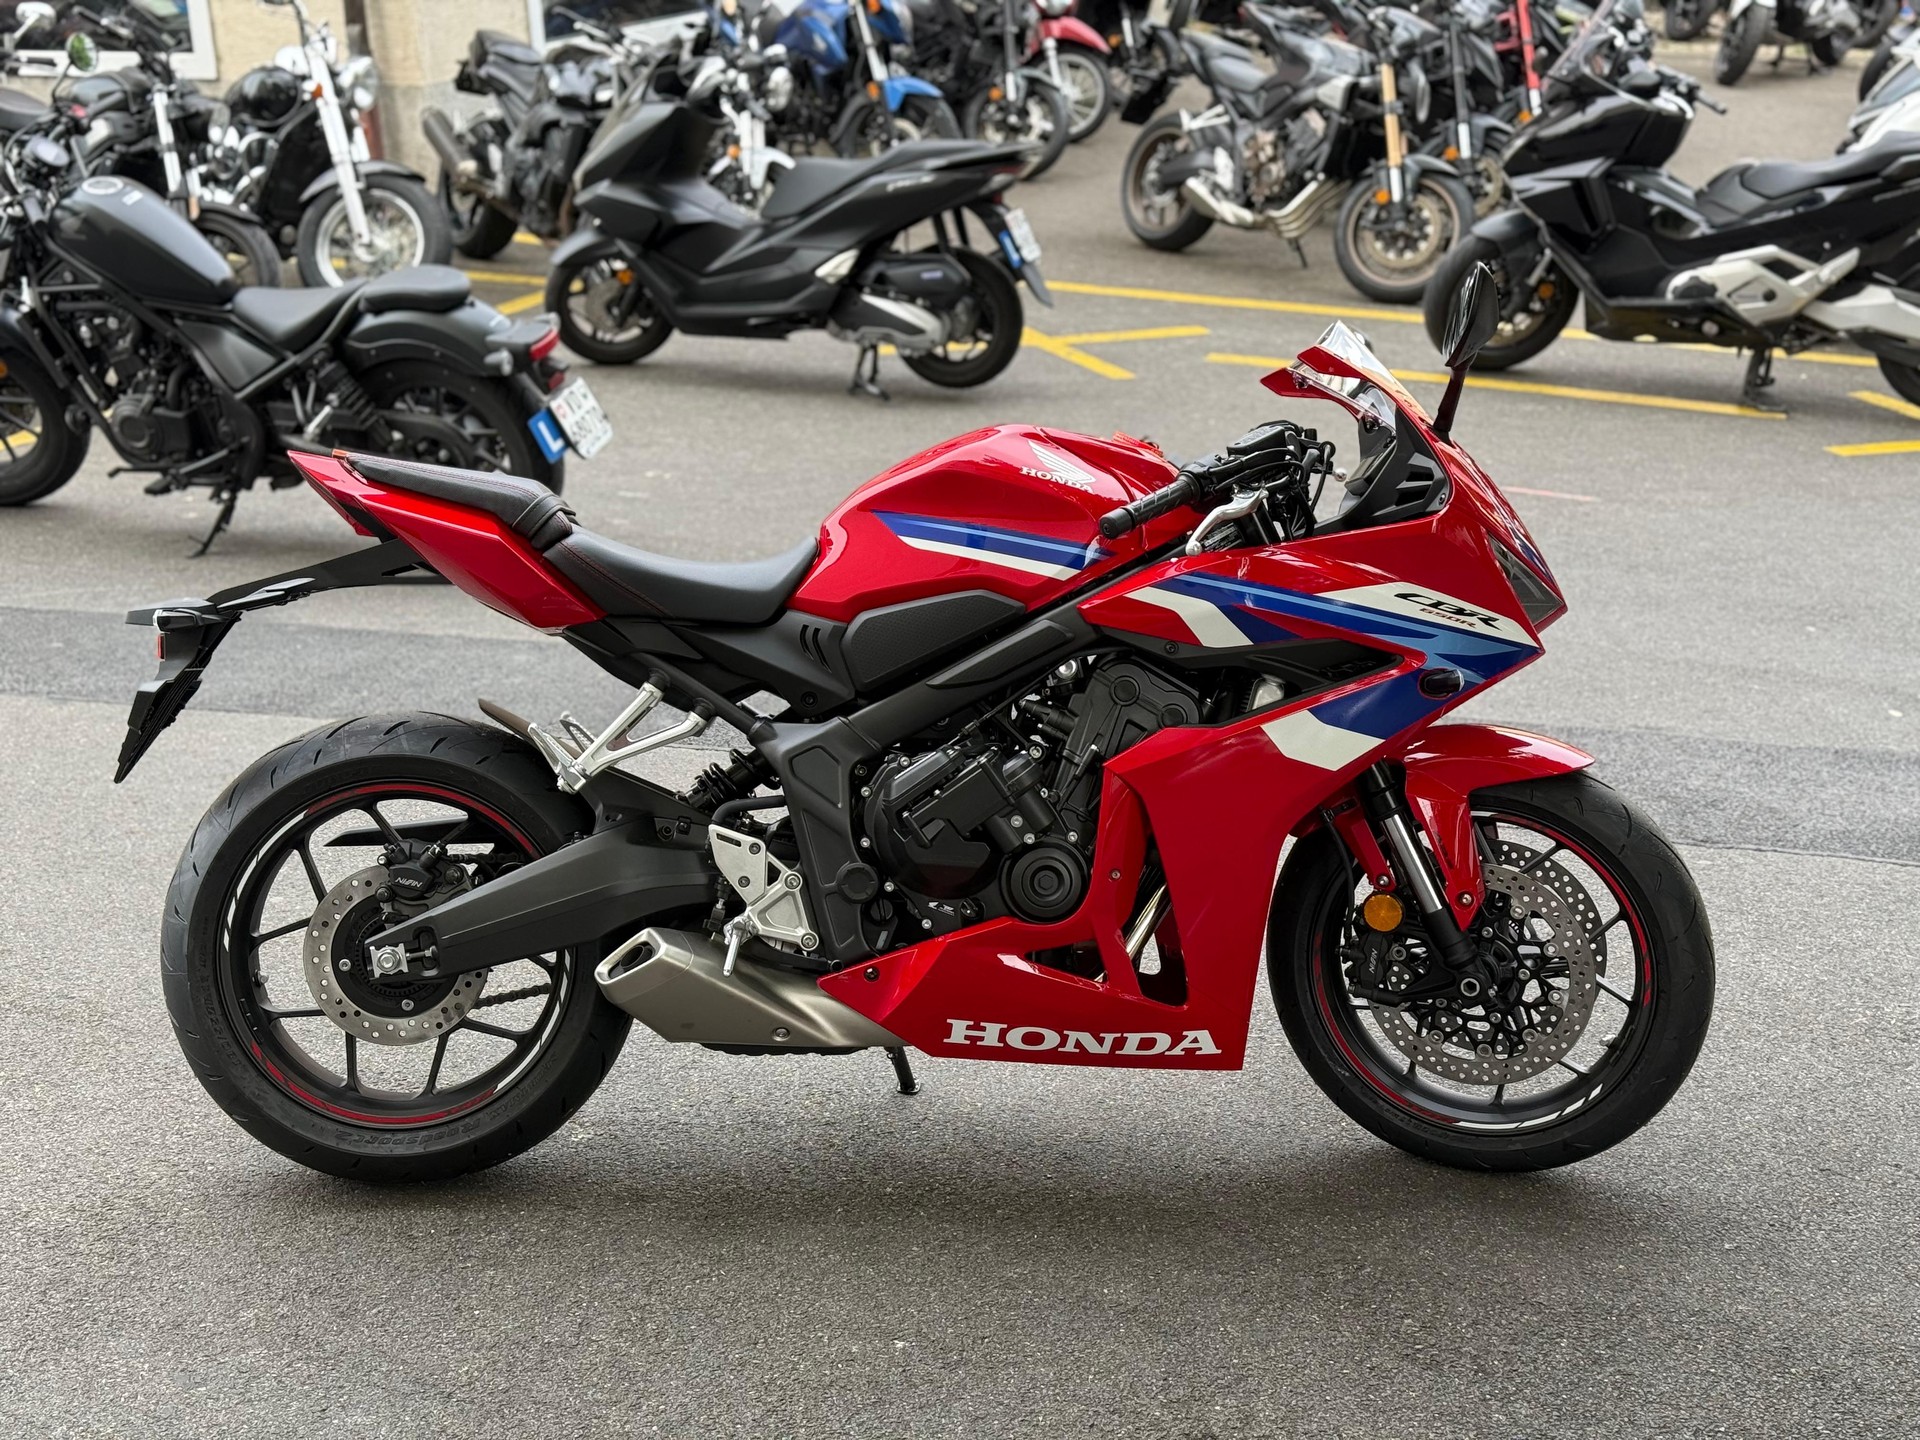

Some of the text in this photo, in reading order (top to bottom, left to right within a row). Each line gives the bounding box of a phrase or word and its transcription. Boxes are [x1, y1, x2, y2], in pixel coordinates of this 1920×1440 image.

[537, 421, 565, 454] L
[1019, 465, 1095, 496] HONDA
[1394, 592, 1502, 632] CBR
[1419, 607, 1477, 629] 650R
[943, 1018, 1222, 1056] HONDA
